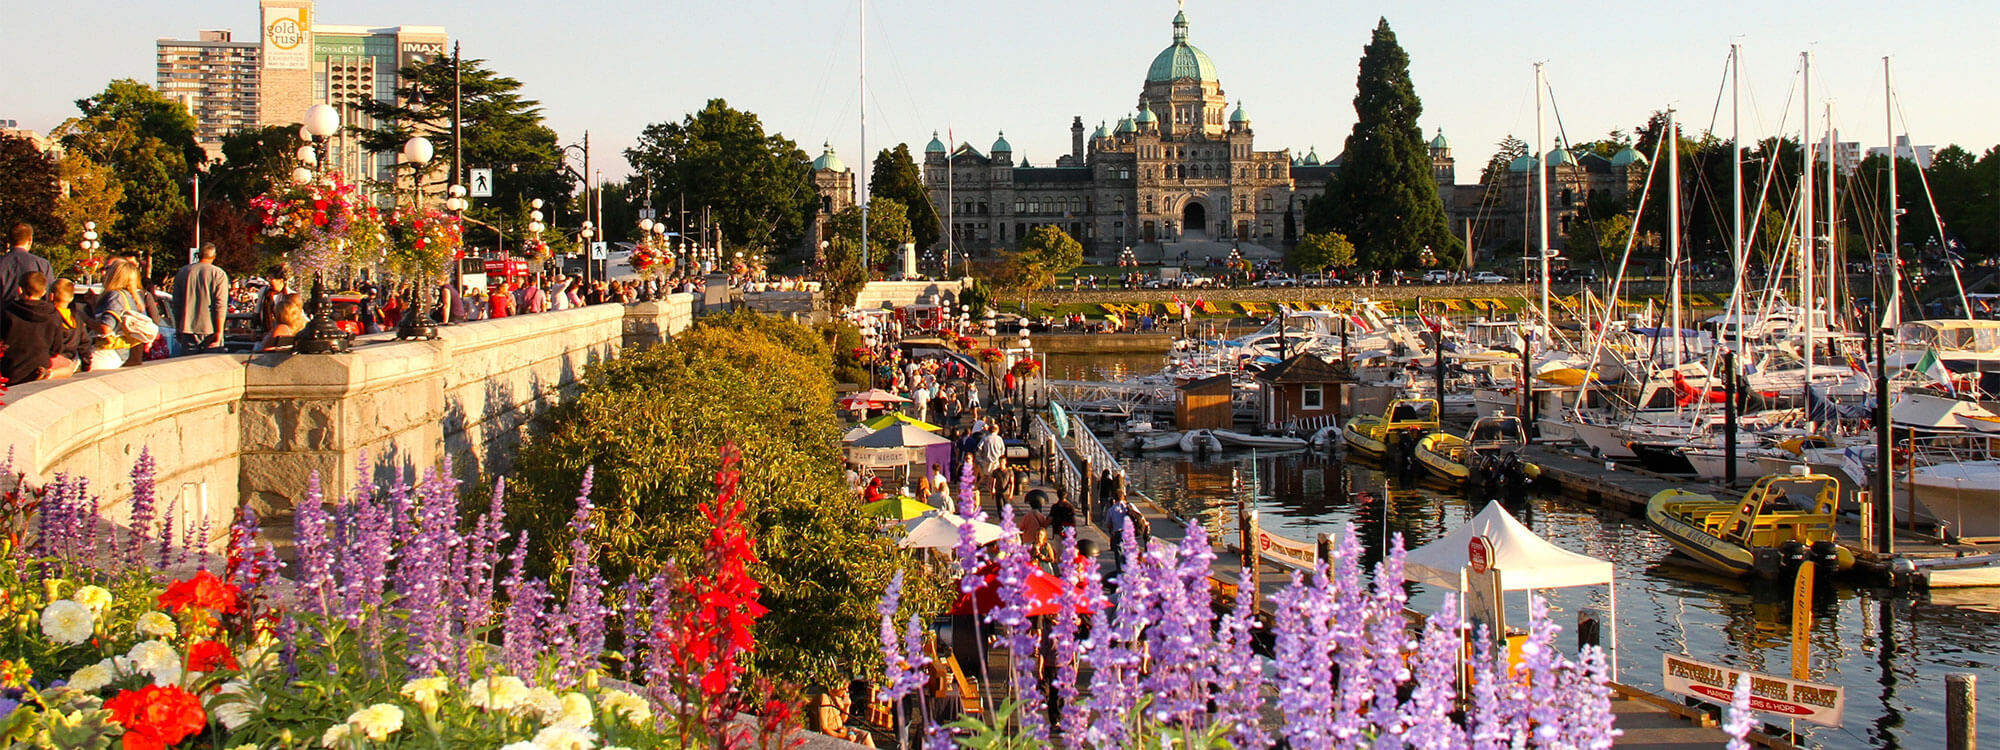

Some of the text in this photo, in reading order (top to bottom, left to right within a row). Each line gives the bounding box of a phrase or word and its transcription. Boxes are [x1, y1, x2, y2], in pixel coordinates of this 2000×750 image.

[266, 22, 295, 37] gold
[403, 43, 442, 53] IMAX
[1773, 703, 1796, 714] HOPS
